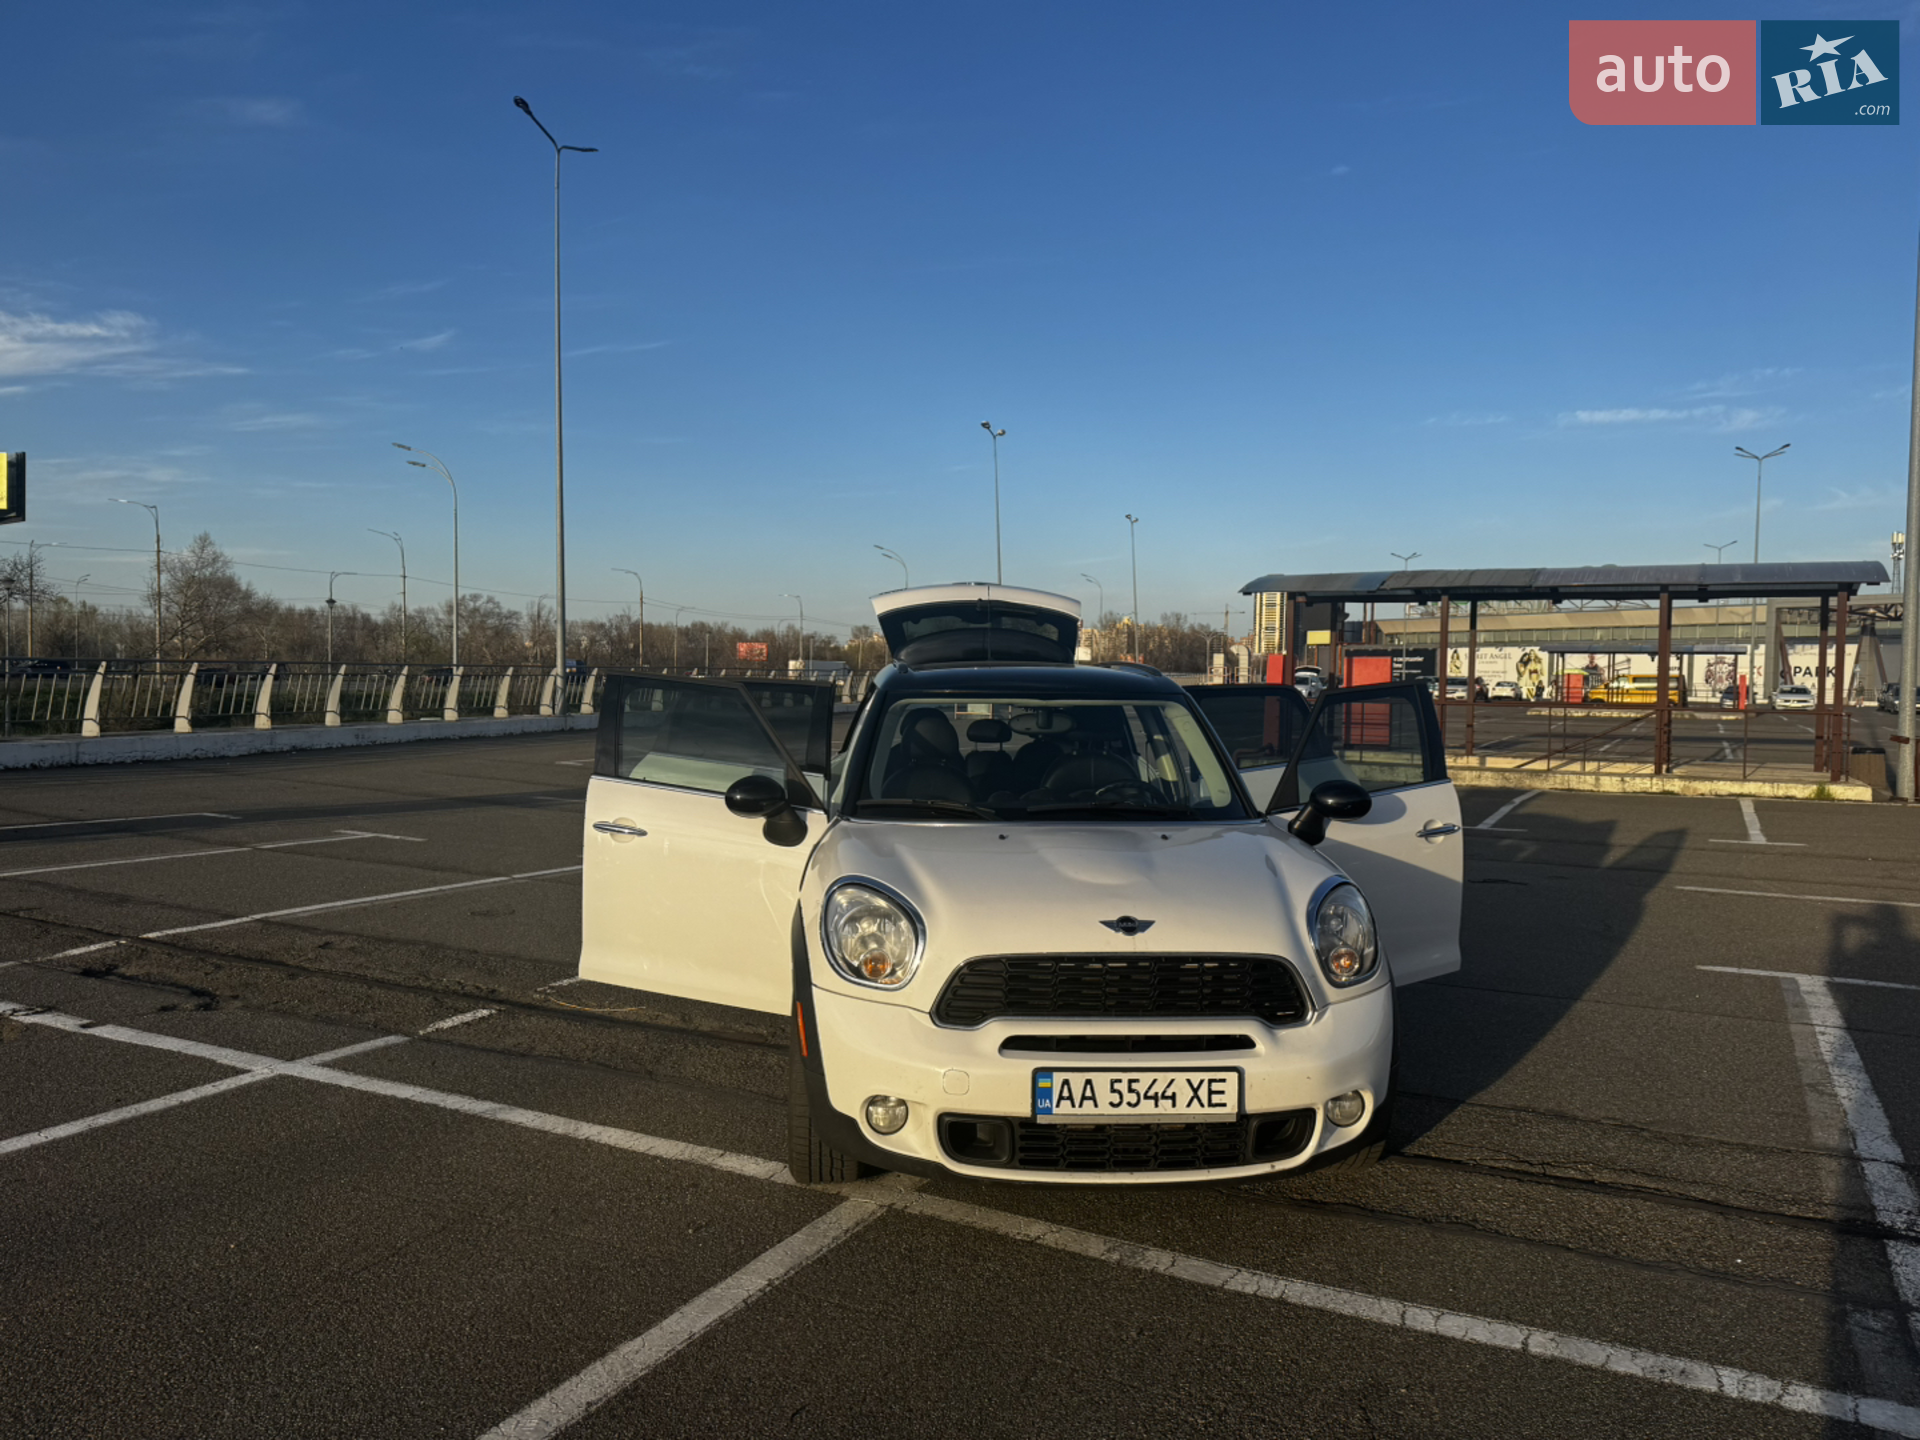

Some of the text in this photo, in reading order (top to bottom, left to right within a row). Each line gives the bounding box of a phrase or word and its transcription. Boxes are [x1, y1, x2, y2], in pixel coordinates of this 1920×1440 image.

[1037, 1098, 1051, 1108] UA
[1055, 1078, 1227, 1108] AA 5544 XE
